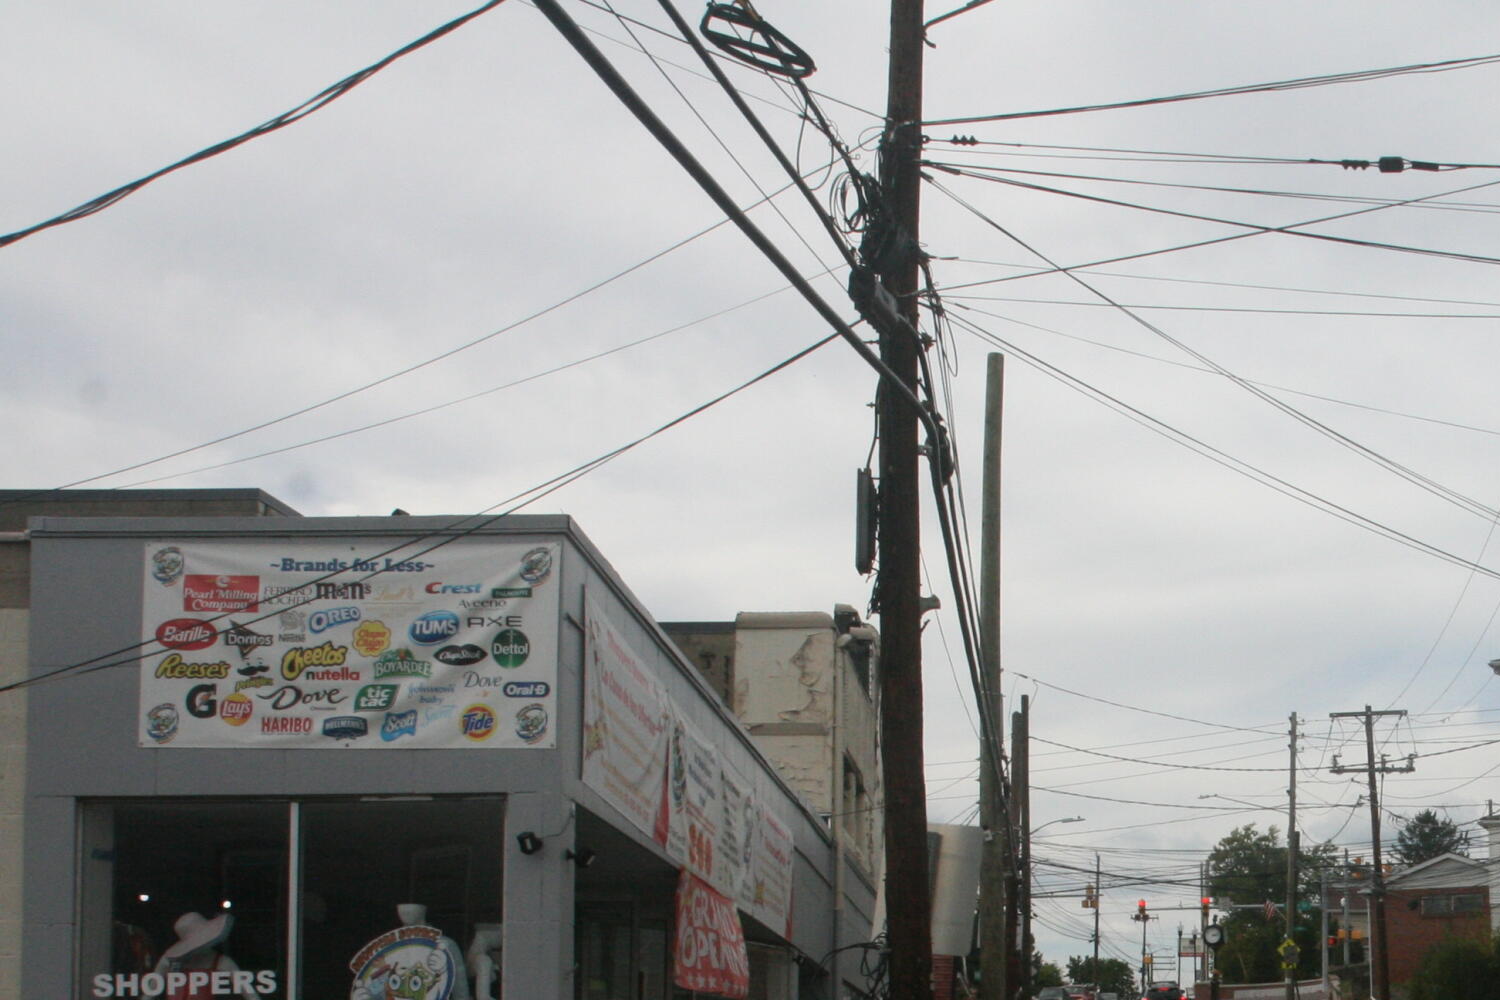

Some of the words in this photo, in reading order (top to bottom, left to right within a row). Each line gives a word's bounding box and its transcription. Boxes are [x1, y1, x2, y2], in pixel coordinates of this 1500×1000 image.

[352, 557, 379, 572] for
[184, 587, 214, 598] Pearl
[216, 588, 258, 600] Milling
[424, 581, 482, 595] Crest
[192, 600, 250, 612] Company
[458, 599, 507, 608] Aveeno
[414, 620, 457, 636] TUMS
[466, 615, 522, 627] AXE
[164, 626, 211, 642] Barilla
[227, 633, 273, 646] Doritos
[493, 642, 529, 655] Dettol
[283, 641, 347, 680] Cheetos
[305, 667, 360, 681] nutella
[464, 671, 503, 688] Dove
[366, 687, 392, 698] tic
[506, 684, 545, 696] Oral-B
[257, 685, 348, 710] Dove
[360, 696, 387, 707] tac
[261, 716, 313, 733] HARIBO
[464, 712, 494, 734] Tide
[92, 970, 277, 997] SHOPPERS
